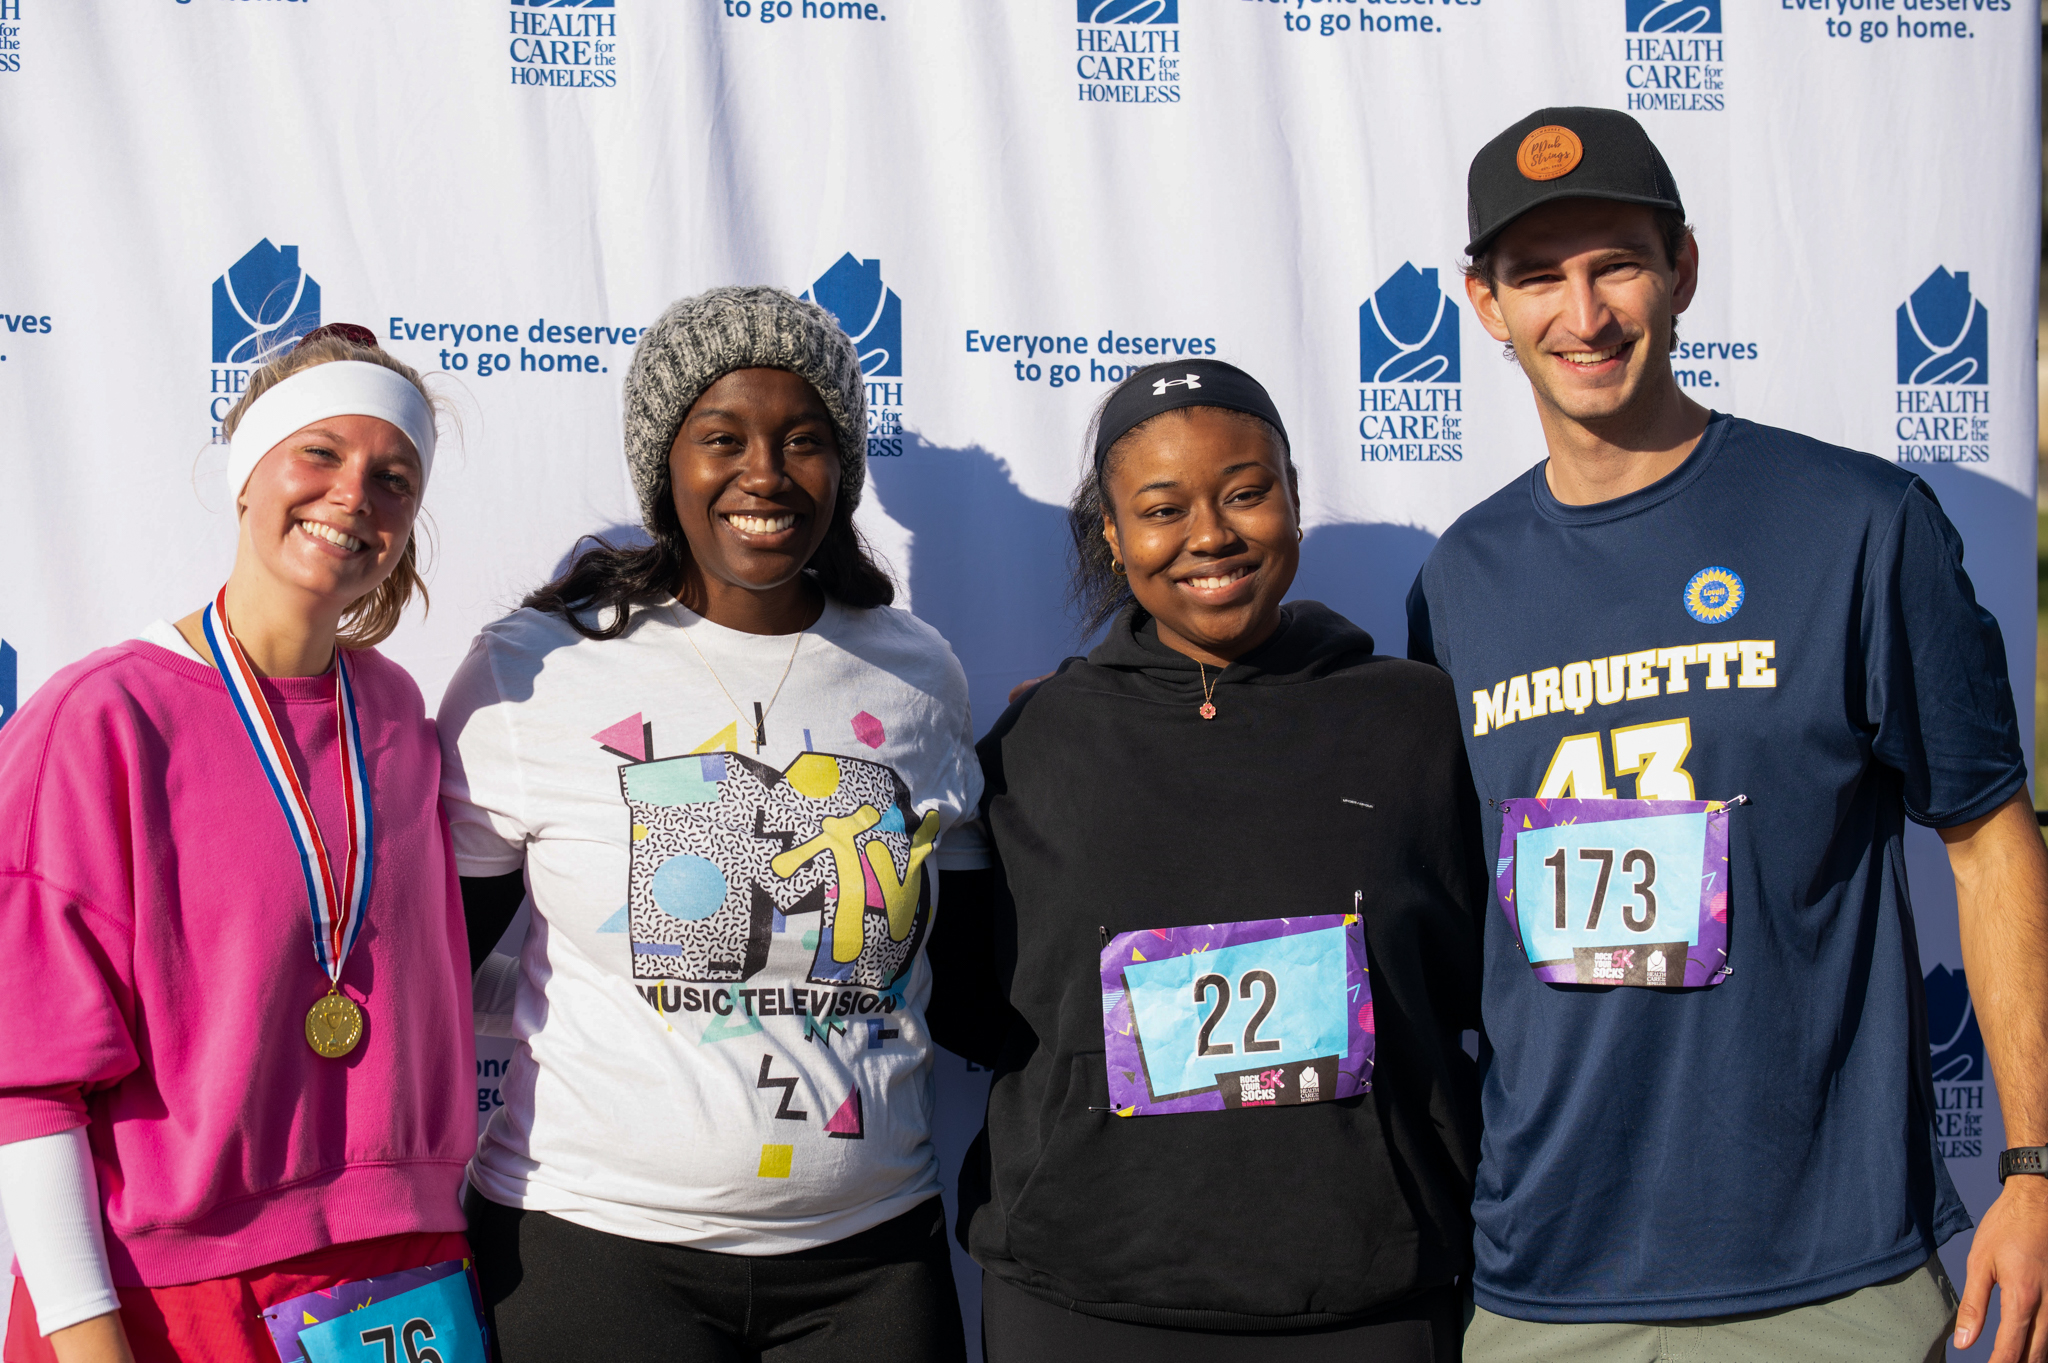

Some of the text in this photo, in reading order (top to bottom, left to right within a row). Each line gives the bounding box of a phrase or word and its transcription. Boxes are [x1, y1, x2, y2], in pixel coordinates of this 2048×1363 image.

[510, 11, 616, 36] HEALTH
[724, 0, 886, 24] to go home.
[1284, 8, 1442, 37] to go home.
[1826, 14, 1974, 43] to go home.
[510, 38, 616, 65] CARE for
[1076, 29, 1180, 53] HEALTH
[1625, 39, 1723, 62] HEALTH
[594, 53, 616, 66] the
[1077, 55, 1180, 81] CARE for
[511, 66, 616, 88] HOMELESS
[1159, 69, 1180, 81] the
[1626, 64, 1723, 89] CARE for
[1704, 77, 1724, 90] the
[1078, 84, 1181, 103] HOMELESS
[1627, 93, 1724, 112] HOMELESS
[390, 317, 646, 347] Everyone deserve
[966, 330, 1217, 358] Everyone deserves
[439, 347, 608, 377] to go home.
[1014, 359, 1042, 382] to
[1049, 363, 1081, 388] go
[1359, 389, 1462, 412] HEALTH
[1896, 390, 1990, 413] HEALTH
[881, 408, 902, 422] for
[881, 422, 903, 435] the
[1359, 414, 1462, 440] CARE for
[1442, 427, 1462, 440] the
[1896, 416, 1989, 441] CARE for
[1971, 429, 1989, 441] the
[1361, 444, 1463, 462] HOMELESS
[1897, 445, 1990, 463] HOMELESS
[1472, 640, 1777, 737] MARQUETTE
[1544, 847, 1658, 933] 173
[1611, 949, 1635, 969] 5K
[1592, 967, 1624, 979] SOCKS
[635, 984, 897, 1017] MUSIC TELEVISION
[1194, 969, 1282, 1058] 22
[1240, 1075, 1260, 1083] ROCK
[1240, 1082, 1260, 1091] YOUR
[1260, 1068, 1285, 1089] 5K
[1241, 1089, 1276, 1101] SOCKS
[1964, 1111, 1982, 1124] for
[1964, 1123, 1982, 1137] the
